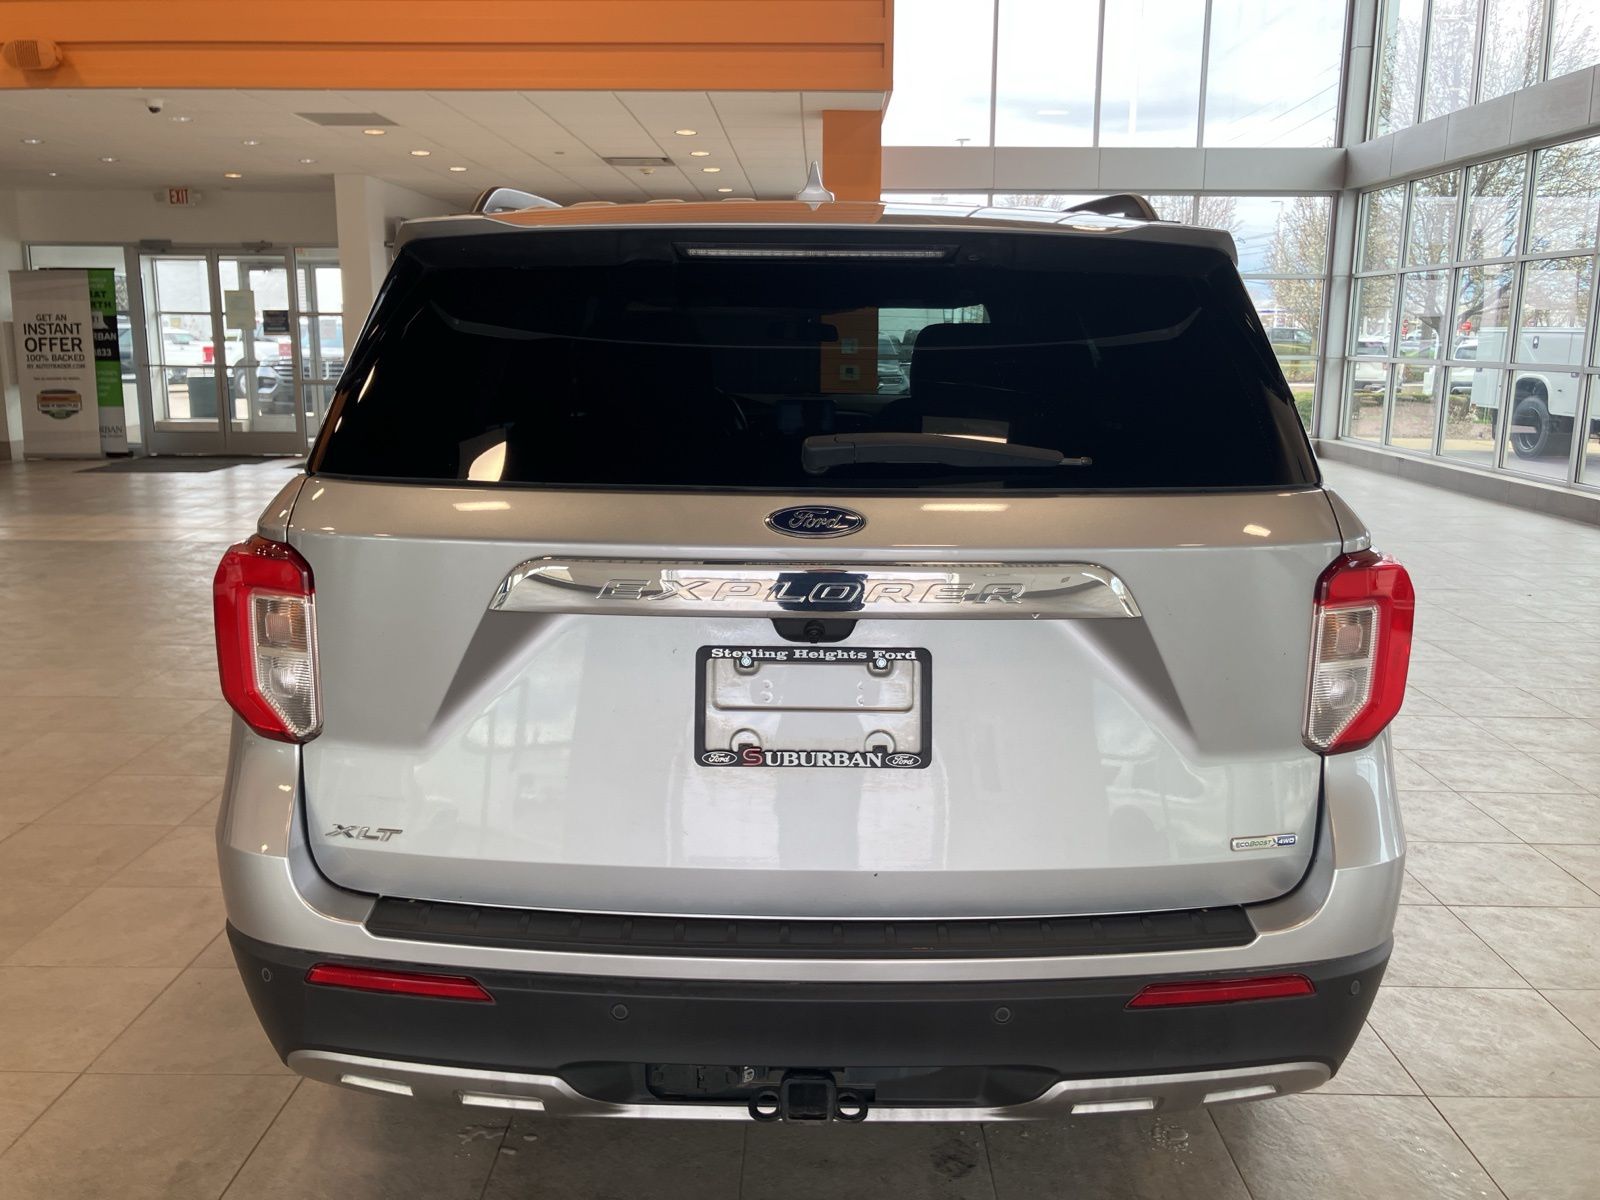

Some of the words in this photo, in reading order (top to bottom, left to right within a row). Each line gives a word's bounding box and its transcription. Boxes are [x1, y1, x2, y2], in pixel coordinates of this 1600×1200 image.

[169, 189, 188, 204] EXIT
[36, 313, 51, 321] GET
[55, 313, 67, 321] AN
[23, 322, 82, 335] INSTANT
[24, 337, 83, 353] OFFER
[26, 354, 50, 362] 100%
[51, 354, 85, 362] BACKED
[595, 578, 1026, 604] EXPLORER
[711, 648, 788, 661] Sterling
[793, 649, 868, 661] Heights
[873, 650, 916, 661] Ford
[707, 752, 731, 764] Ford
[743, 748, 883, 767] SUBURBAN
[891, 754, 915, 767] Ford
[325, 823, 403, 842] XLT
[1278, 836, 1295, 846] 4WD
